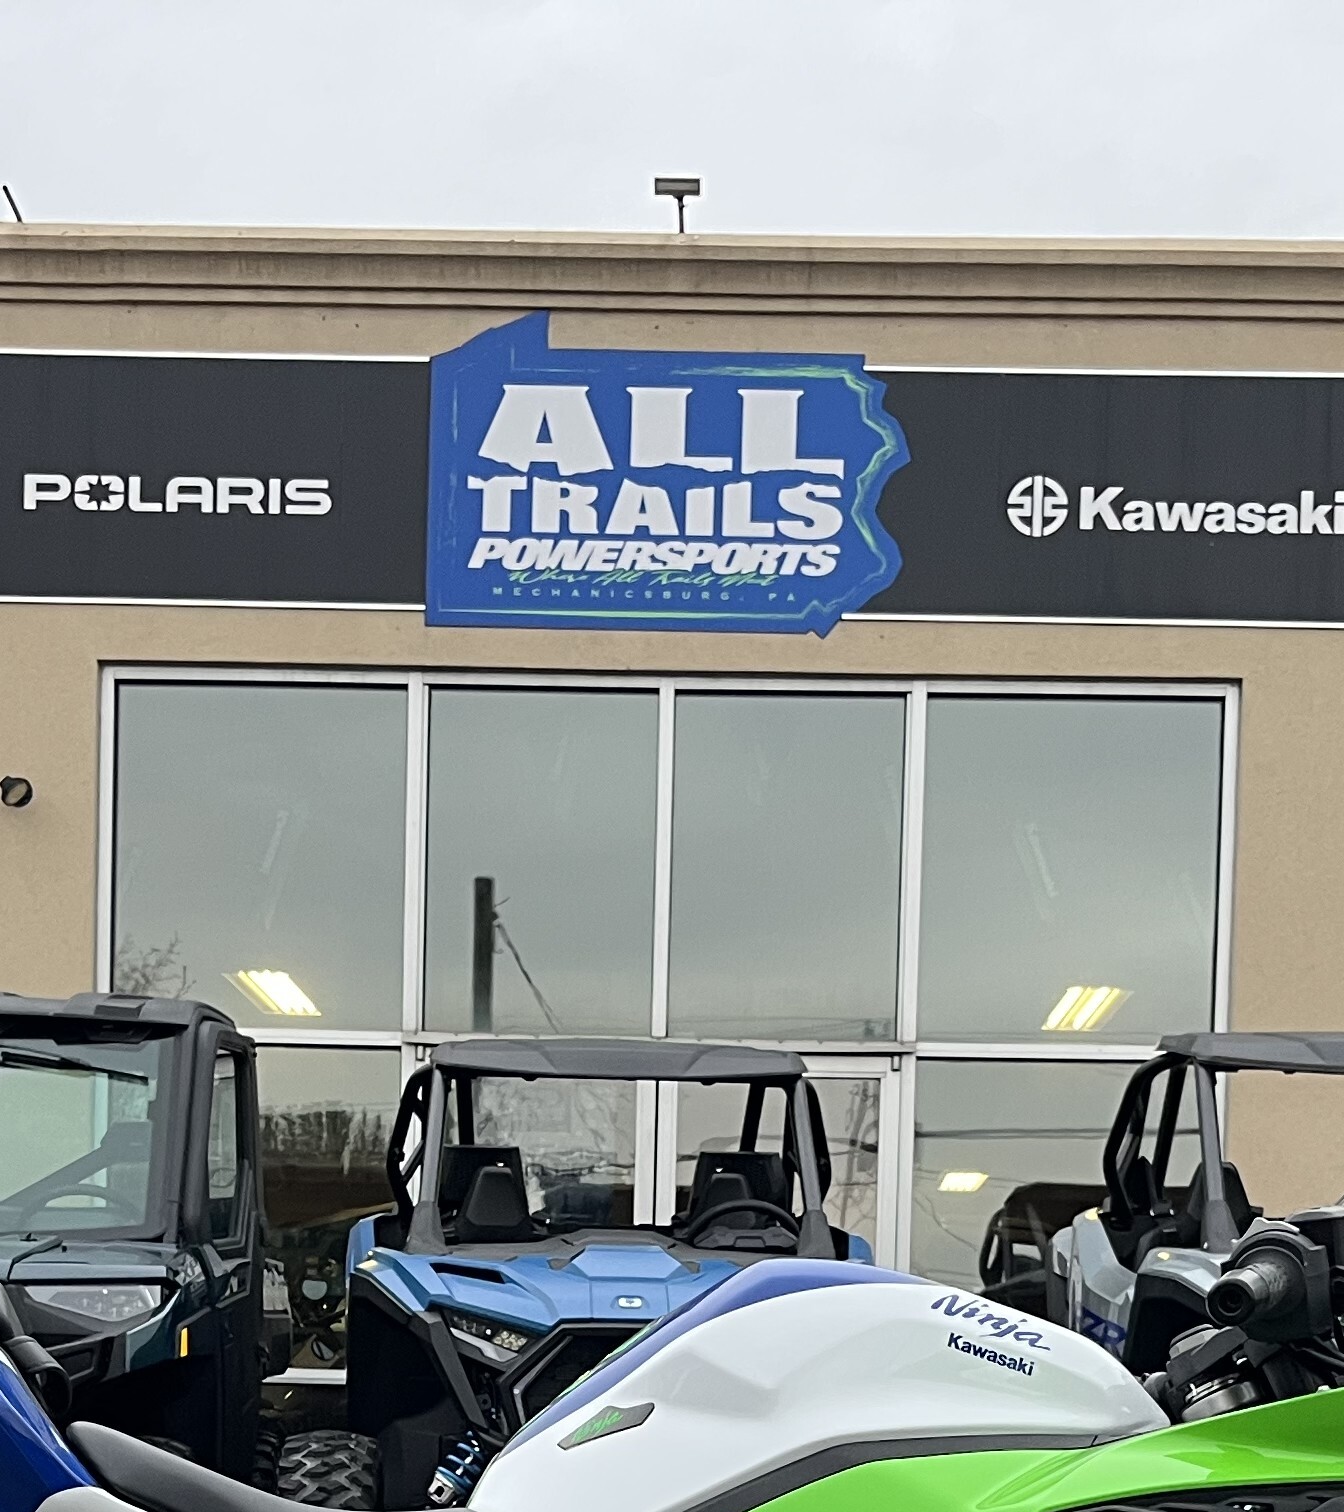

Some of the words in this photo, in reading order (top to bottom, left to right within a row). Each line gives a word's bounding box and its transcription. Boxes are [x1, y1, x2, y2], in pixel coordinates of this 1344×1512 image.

[477, 383, 845, 480] ALL
[22, 472, 333, 516] POLARIS
[467, 475, 844, 540] TRAILS
[467, 537, 841, 577] POWERSPORTS
[768, 592, 797, 603] PA
[930, 1294, 1052, 1351] Ninja
[947, 1332, 1035, 1377] Kawasaki
